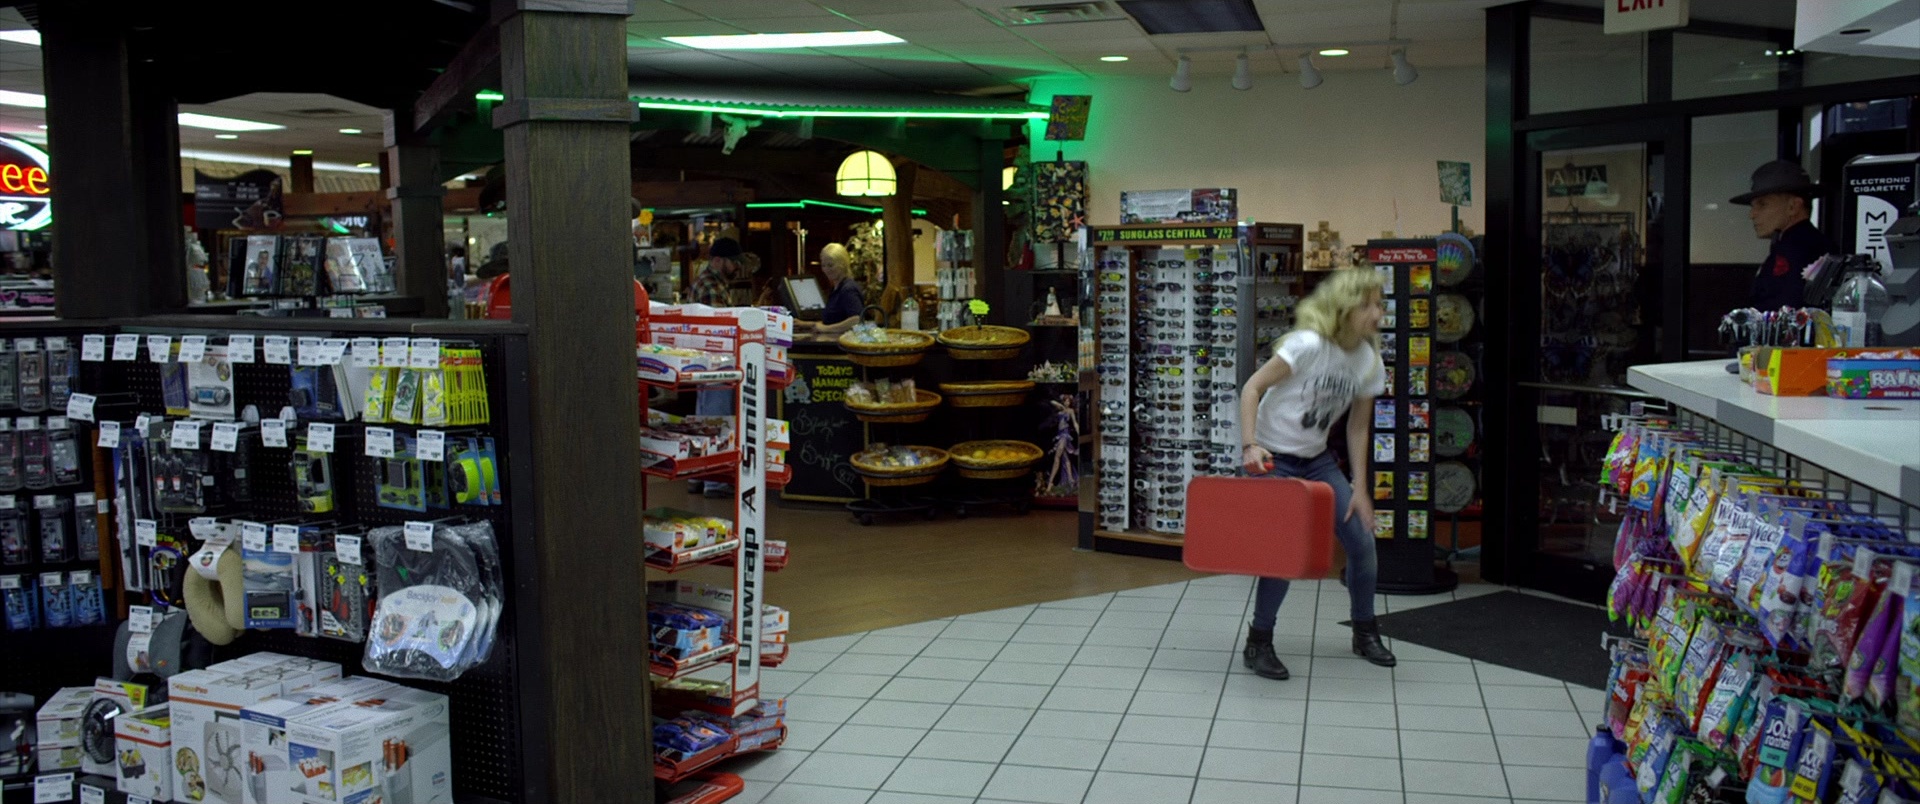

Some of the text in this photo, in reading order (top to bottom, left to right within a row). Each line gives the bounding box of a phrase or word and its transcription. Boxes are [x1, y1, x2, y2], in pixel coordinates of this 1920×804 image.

[1850, 176, 1911, 186] ELECTRONIC
[1853, 185, 1906, 193] CIGARETTE
[1120, 230, 1162, 240] SUNGLASS
[1165, 229, 1207, 239] CENTRAL
[738, 362, 759, 667] Unwrap A Smile
